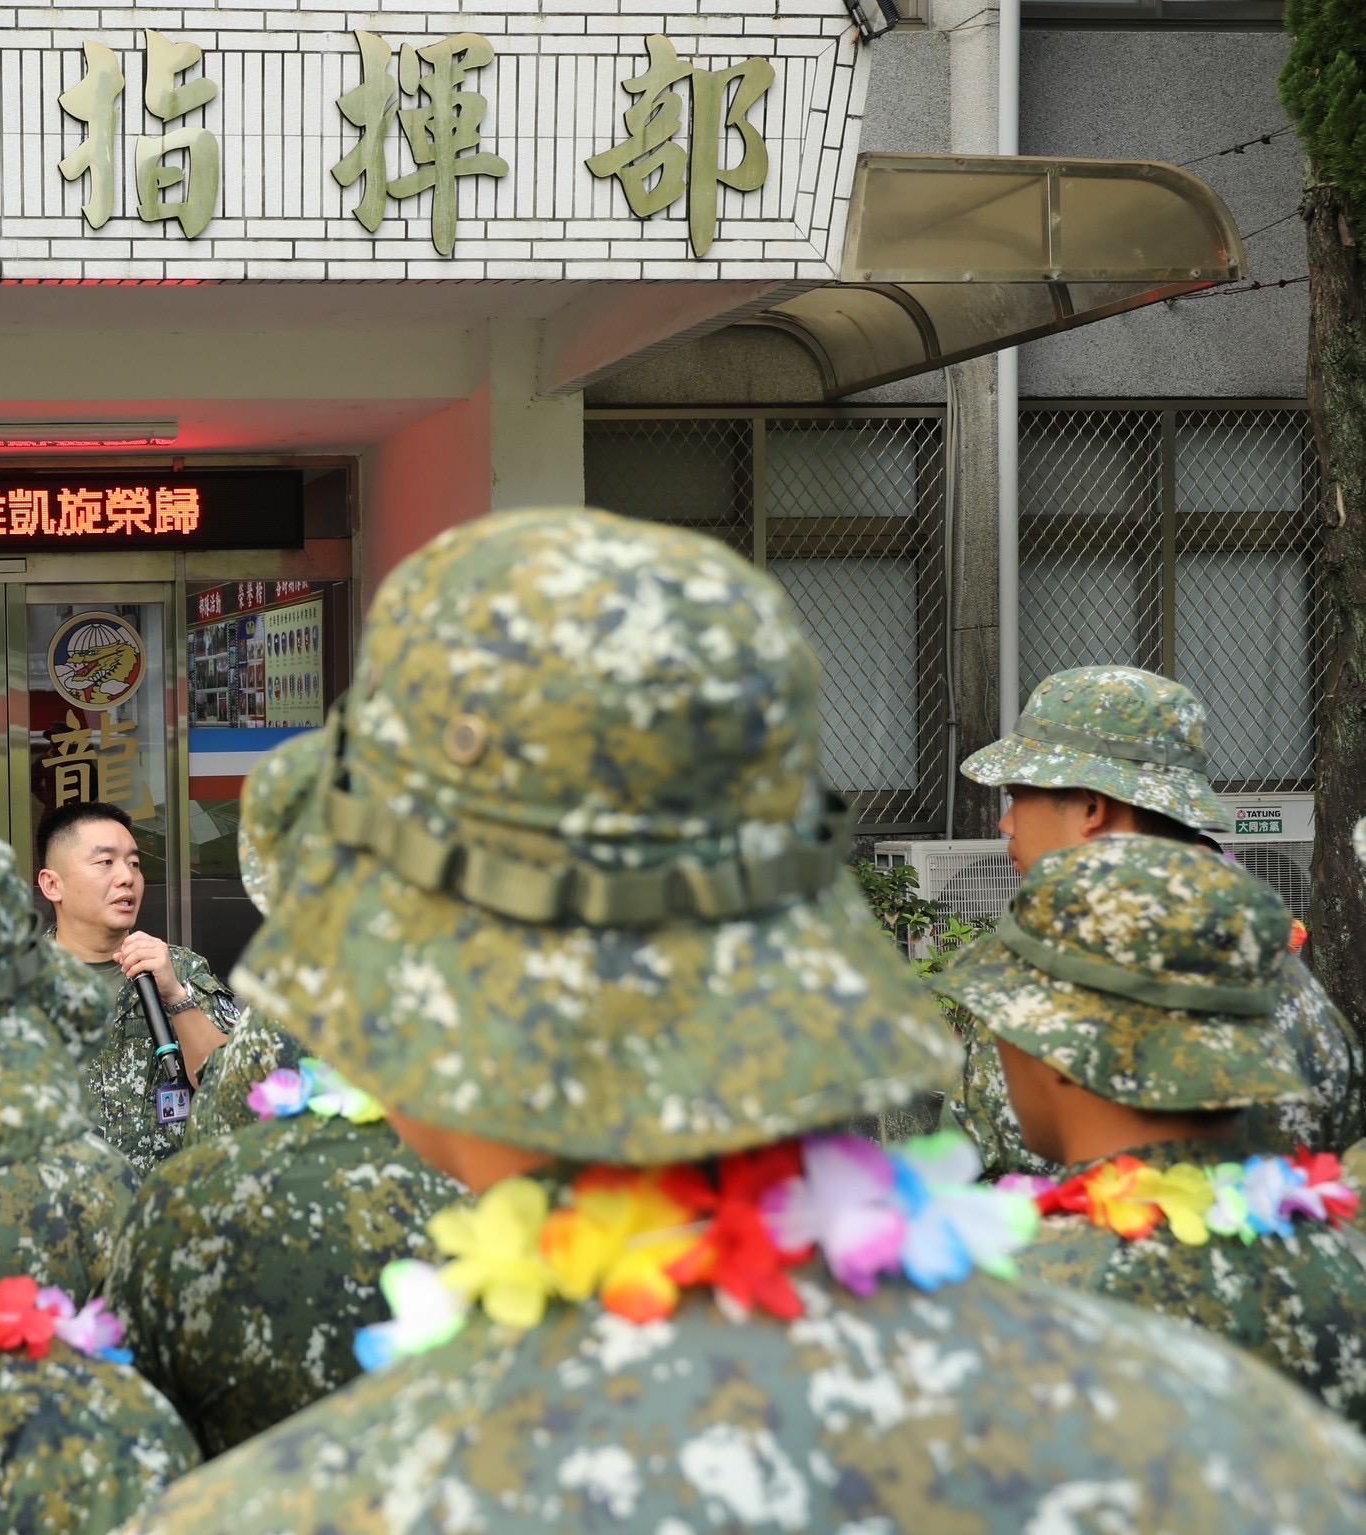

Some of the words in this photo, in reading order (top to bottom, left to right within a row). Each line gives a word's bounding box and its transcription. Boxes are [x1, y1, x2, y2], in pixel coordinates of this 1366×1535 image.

[1246, 810, 1281, 818] TATUNG
[1238, 821, 1280, 833] 大同冷氣
